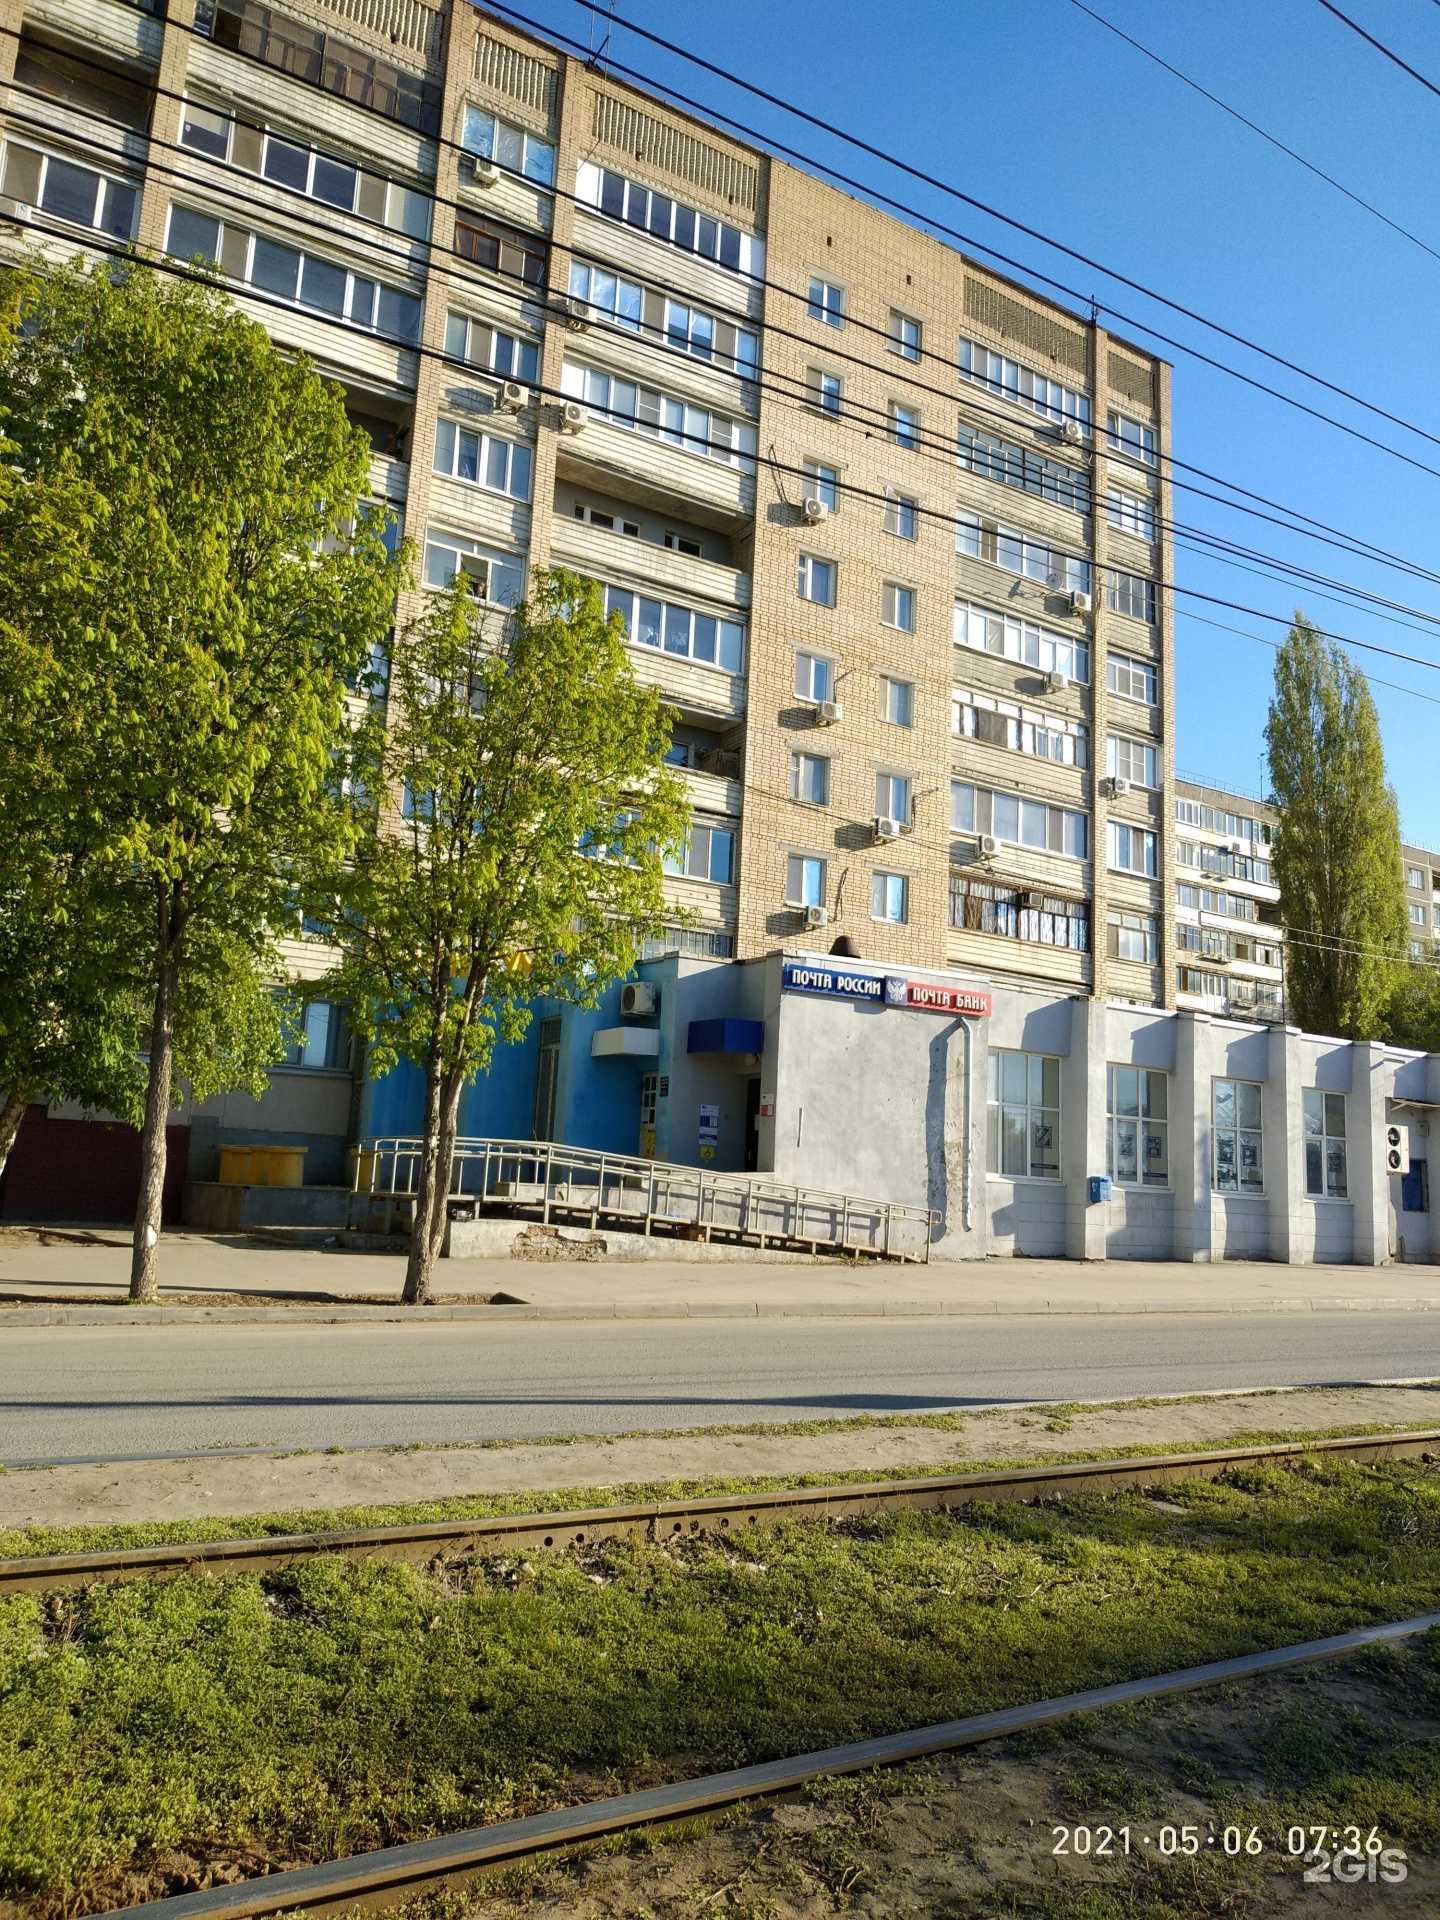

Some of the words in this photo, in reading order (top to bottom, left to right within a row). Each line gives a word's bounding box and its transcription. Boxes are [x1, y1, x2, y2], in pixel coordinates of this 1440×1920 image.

[792, 969, 832, 989] ПОЧТА
[837, 976, 881, 995] РОССИИ
[913, 987, 950, 1005] ПОЧТА
[956, 994, 988, 1011] БАНК
